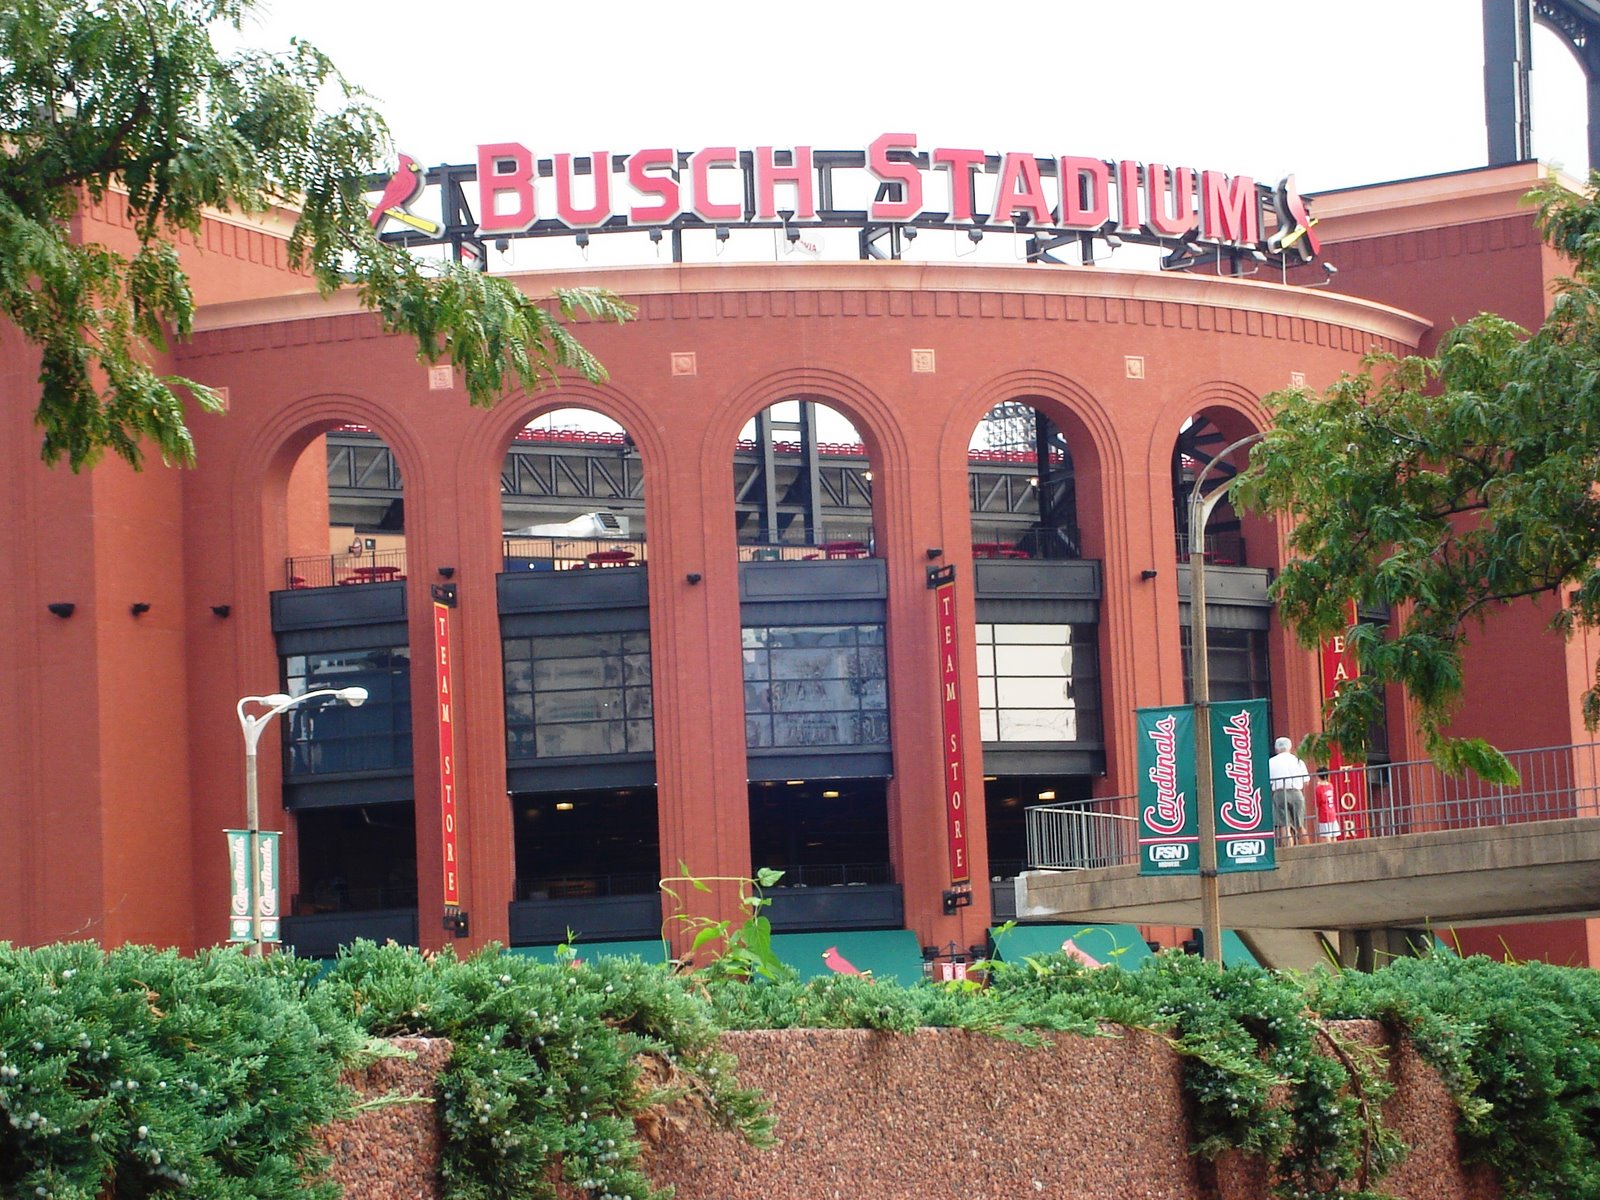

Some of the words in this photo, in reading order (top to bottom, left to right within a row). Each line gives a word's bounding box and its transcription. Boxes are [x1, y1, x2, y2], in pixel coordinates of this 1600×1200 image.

[475, 141, 817, 231] BUSCH
[867, 132, 1260, 246] STADIUM
[438, 617, 450, 723] TEAM
[444, 756, 455, 891] STORE
[943, 597, 956, 701] TEAM
[951, 734, 963, 867] STORE
[1144, 714, 1185, 834] Cardinals
[1220, 709, 1262, 831] Cardinals
[1155, 845, 1182, 860] FSN
[1232, 841, 1259, 856] FSN
